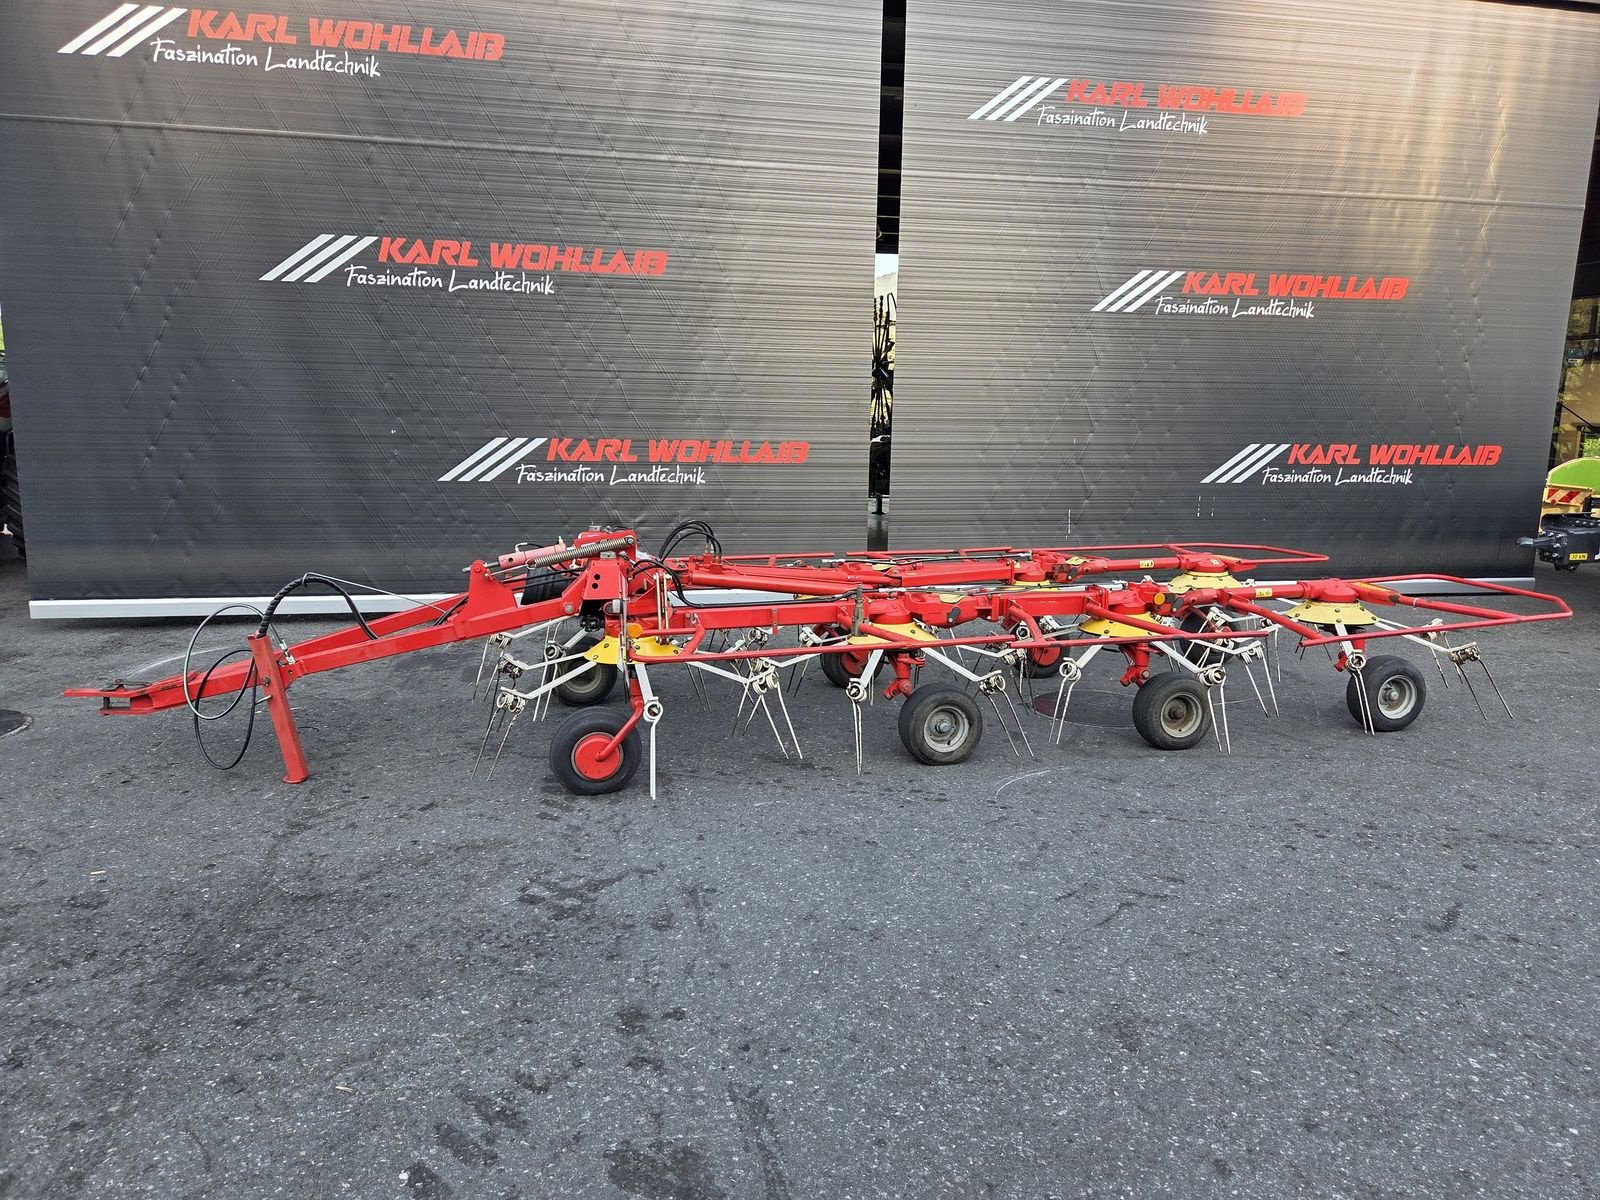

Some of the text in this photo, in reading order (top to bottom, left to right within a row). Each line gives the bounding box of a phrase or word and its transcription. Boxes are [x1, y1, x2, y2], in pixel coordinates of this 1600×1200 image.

[187, 9, 298, 45] KARL
[150, 37, 382, 78] Faszination Landtechnik
[1066, 78, 1148, 108] KARL
[1036, 105, 1208, 135] Faszination Landtechnik
[378, 237, 477, 267] KARL
[344, 264, 555, 296] Faszination Landtechnik
[1182, 271, 1259, 296] KARL
[1154, 295, 1316, 319] Faszination Landtechnik
[546, 438, 638, 462] KARL
[1287, 444, 1361, 465] KARL
[515, 463, 706, 486] Faszination Landtechnik
[1261, 466, 1413, 487] Faszination Landtechnik
